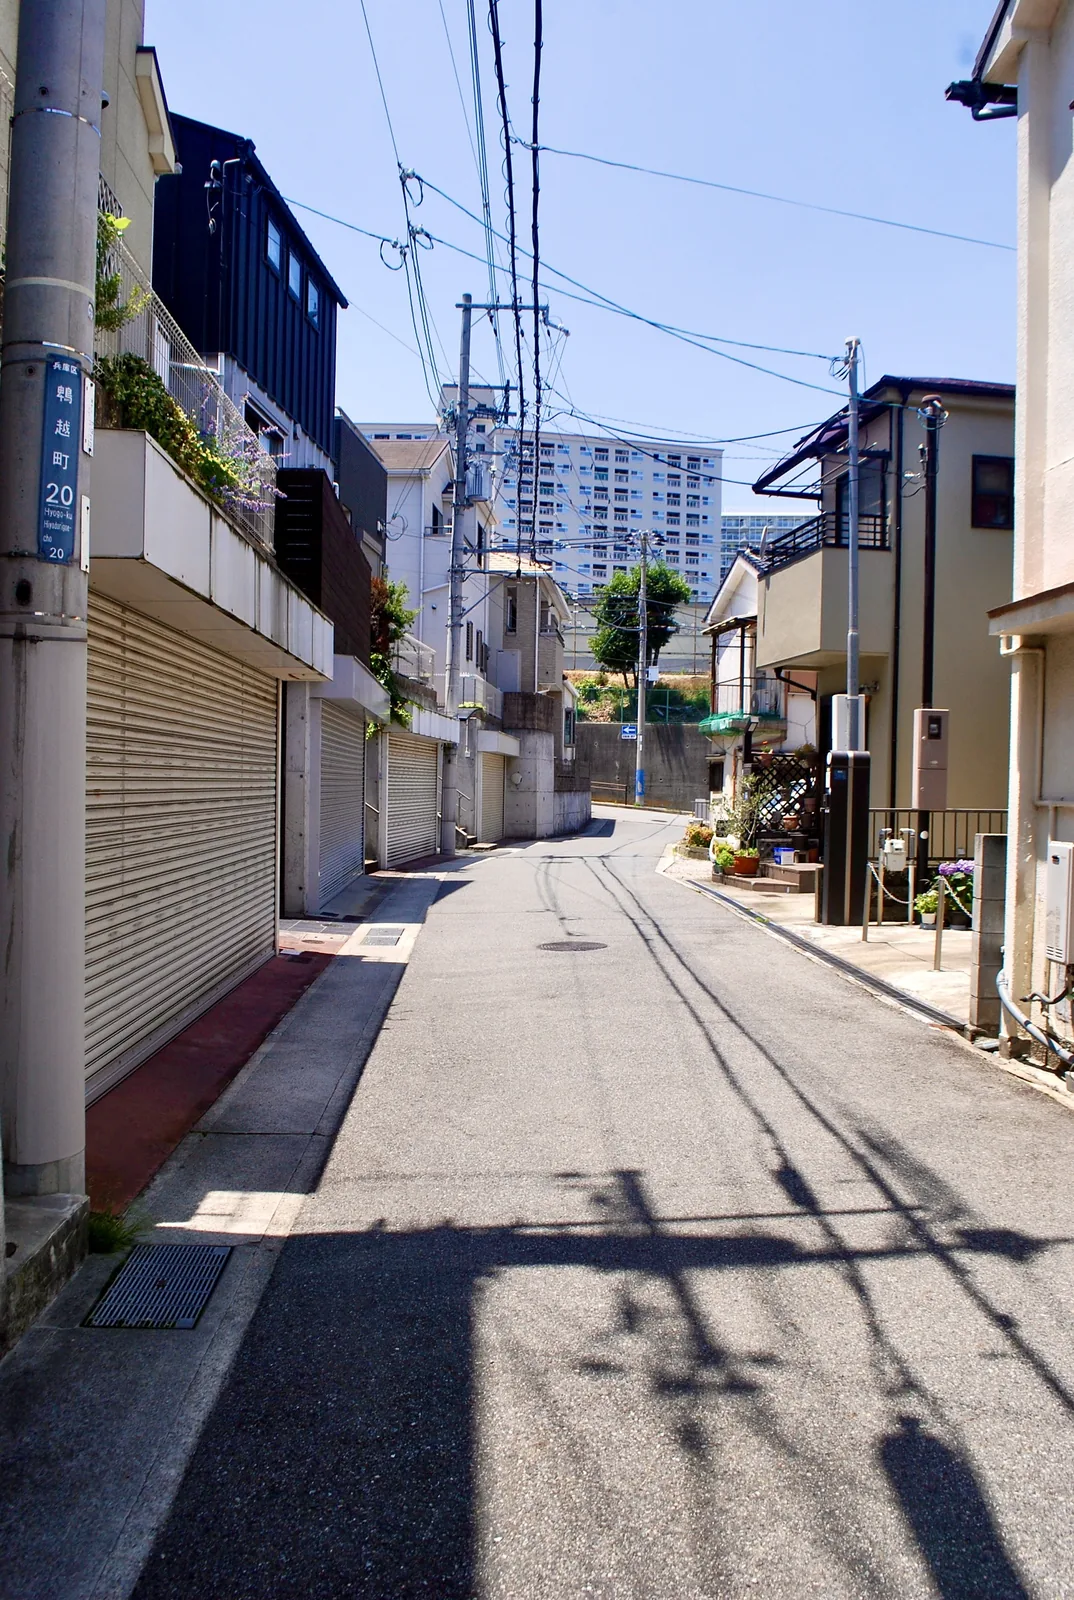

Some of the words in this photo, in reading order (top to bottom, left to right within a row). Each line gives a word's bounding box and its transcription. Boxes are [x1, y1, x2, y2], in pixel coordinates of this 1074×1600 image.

[52, 361, 78, 375] 兵庫区
[46, 482, 73, 506] 20
[44, 507, 73, 520] Hyogo-ku
[43, 534, 53, 543] cho
[49, 547, 64, 559] 20
